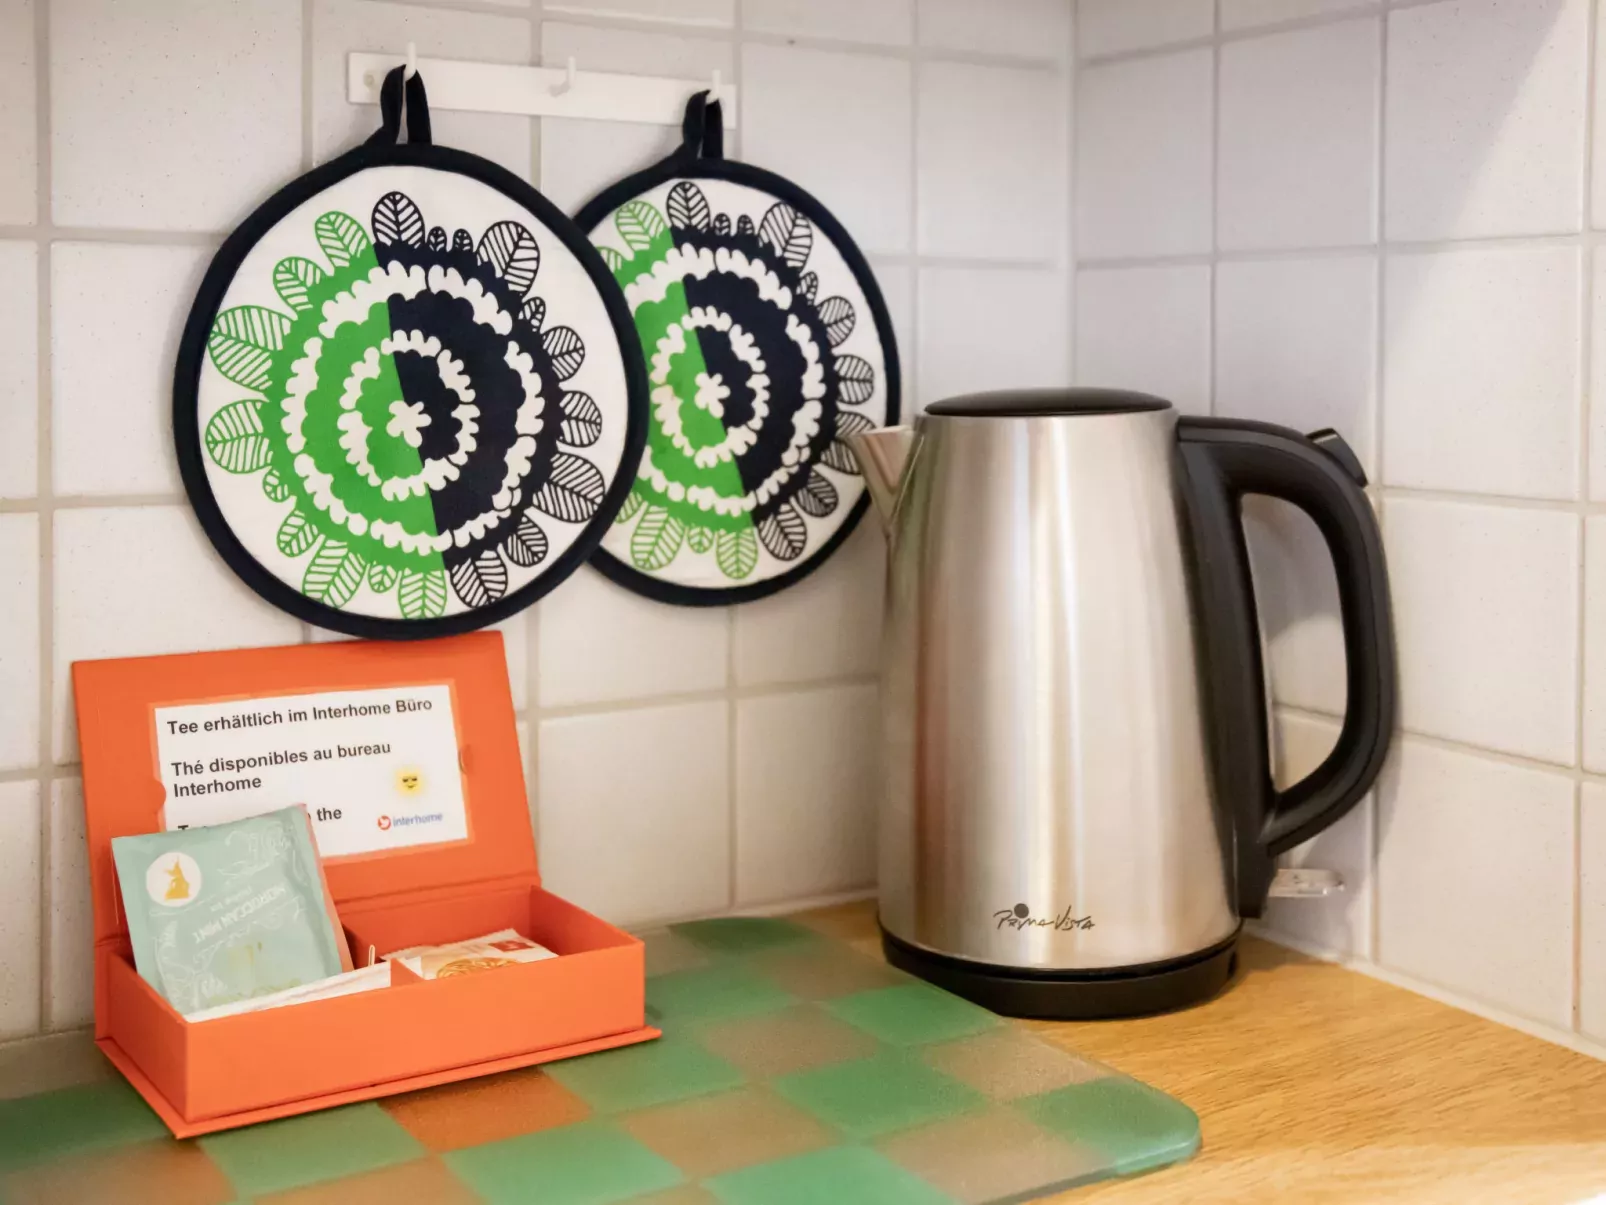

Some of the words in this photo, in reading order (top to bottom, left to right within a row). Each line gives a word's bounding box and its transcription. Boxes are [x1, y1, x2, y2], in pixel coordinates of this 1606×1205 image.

[167, 720, 199, 735] Tee
[203, 710, 283, 733] erhältlich
[288, 708, 308, 723] im
[313, 701, 391, 719] Interhome
[395, 698, 433, 714] Büro
[171, 759, 204, 777] Thé
[209, 748, 308, 774] disponibles
[313, 748, 333, 761] au
[337, 741, 391, 758] bureau
[173, 775, 262, 798] Interhome
[316, 806, 343, 822] the
[392, 811, 443, 828] interhome
